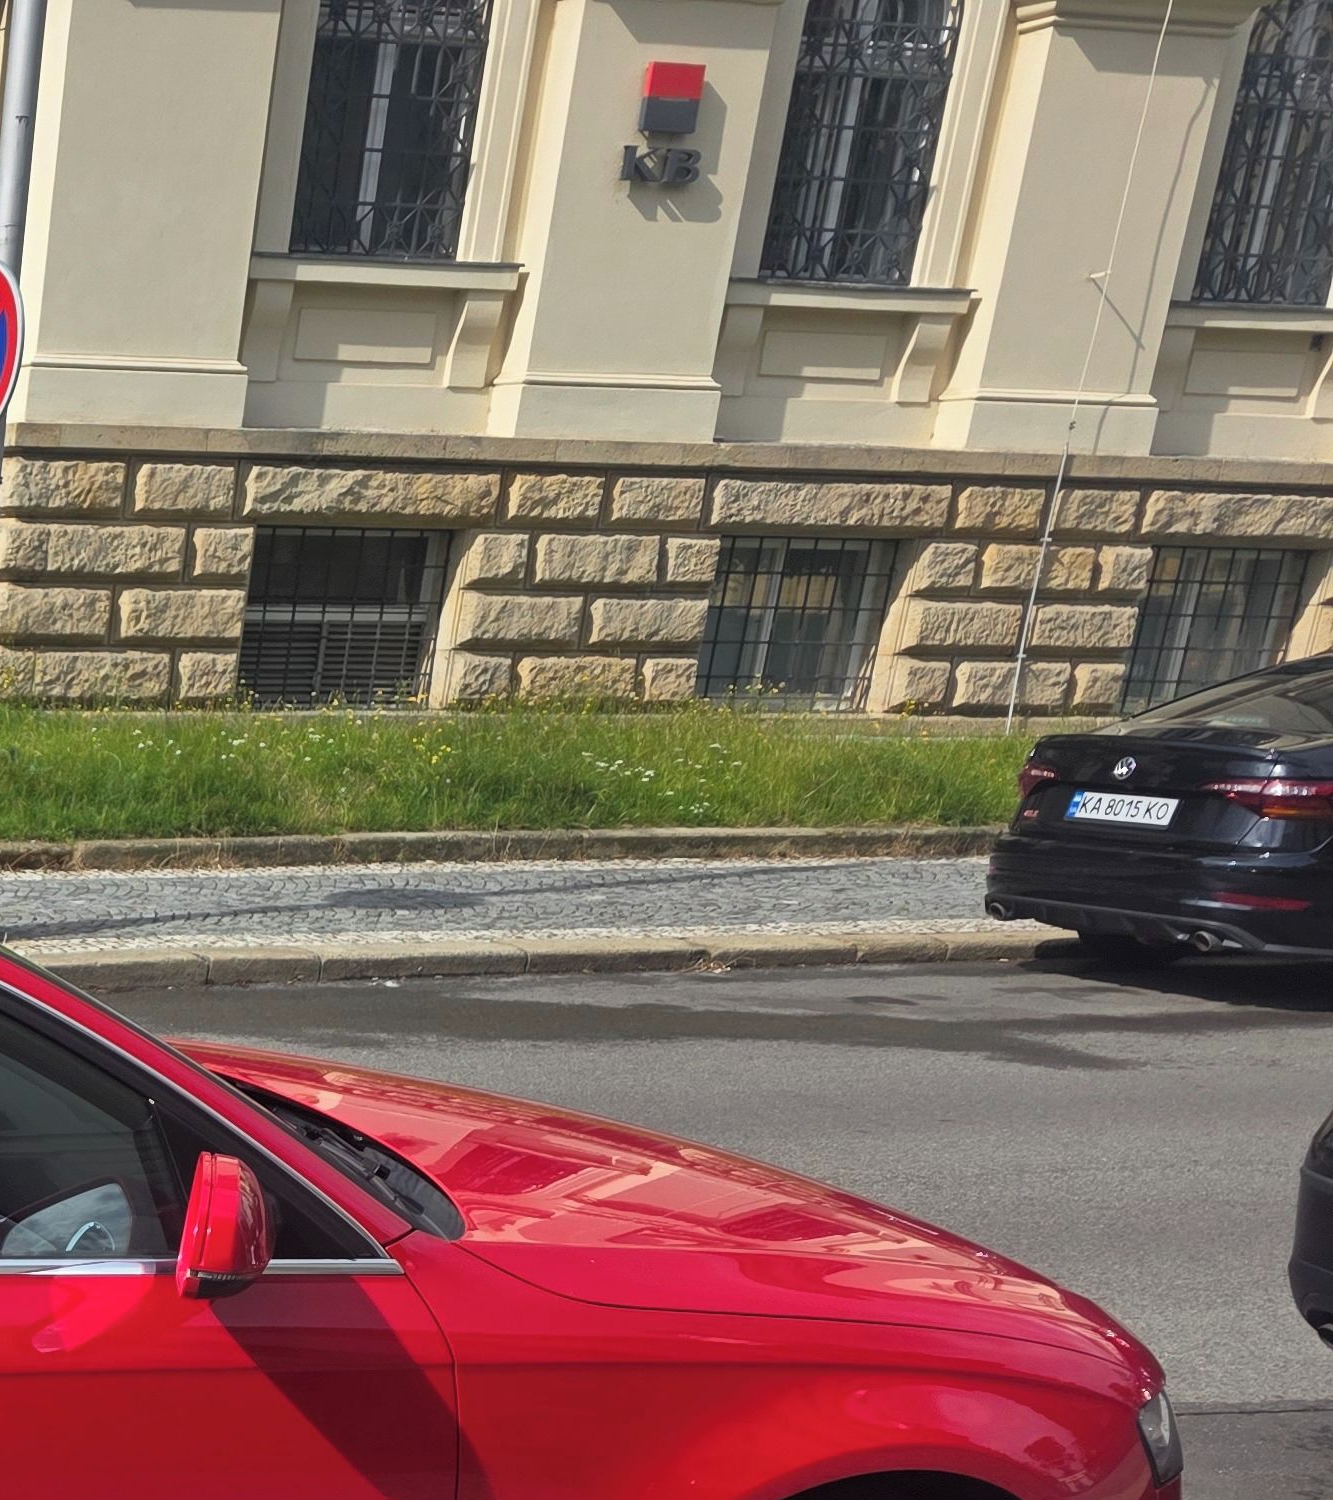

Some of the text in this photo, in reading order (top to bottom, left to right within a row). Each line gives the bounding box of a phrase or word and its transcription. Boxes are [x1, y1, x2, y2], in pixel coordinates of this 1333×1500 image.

[620, 145, 701, 183] KB
[1079, 796, 1169, 820] KA 8015 KO
